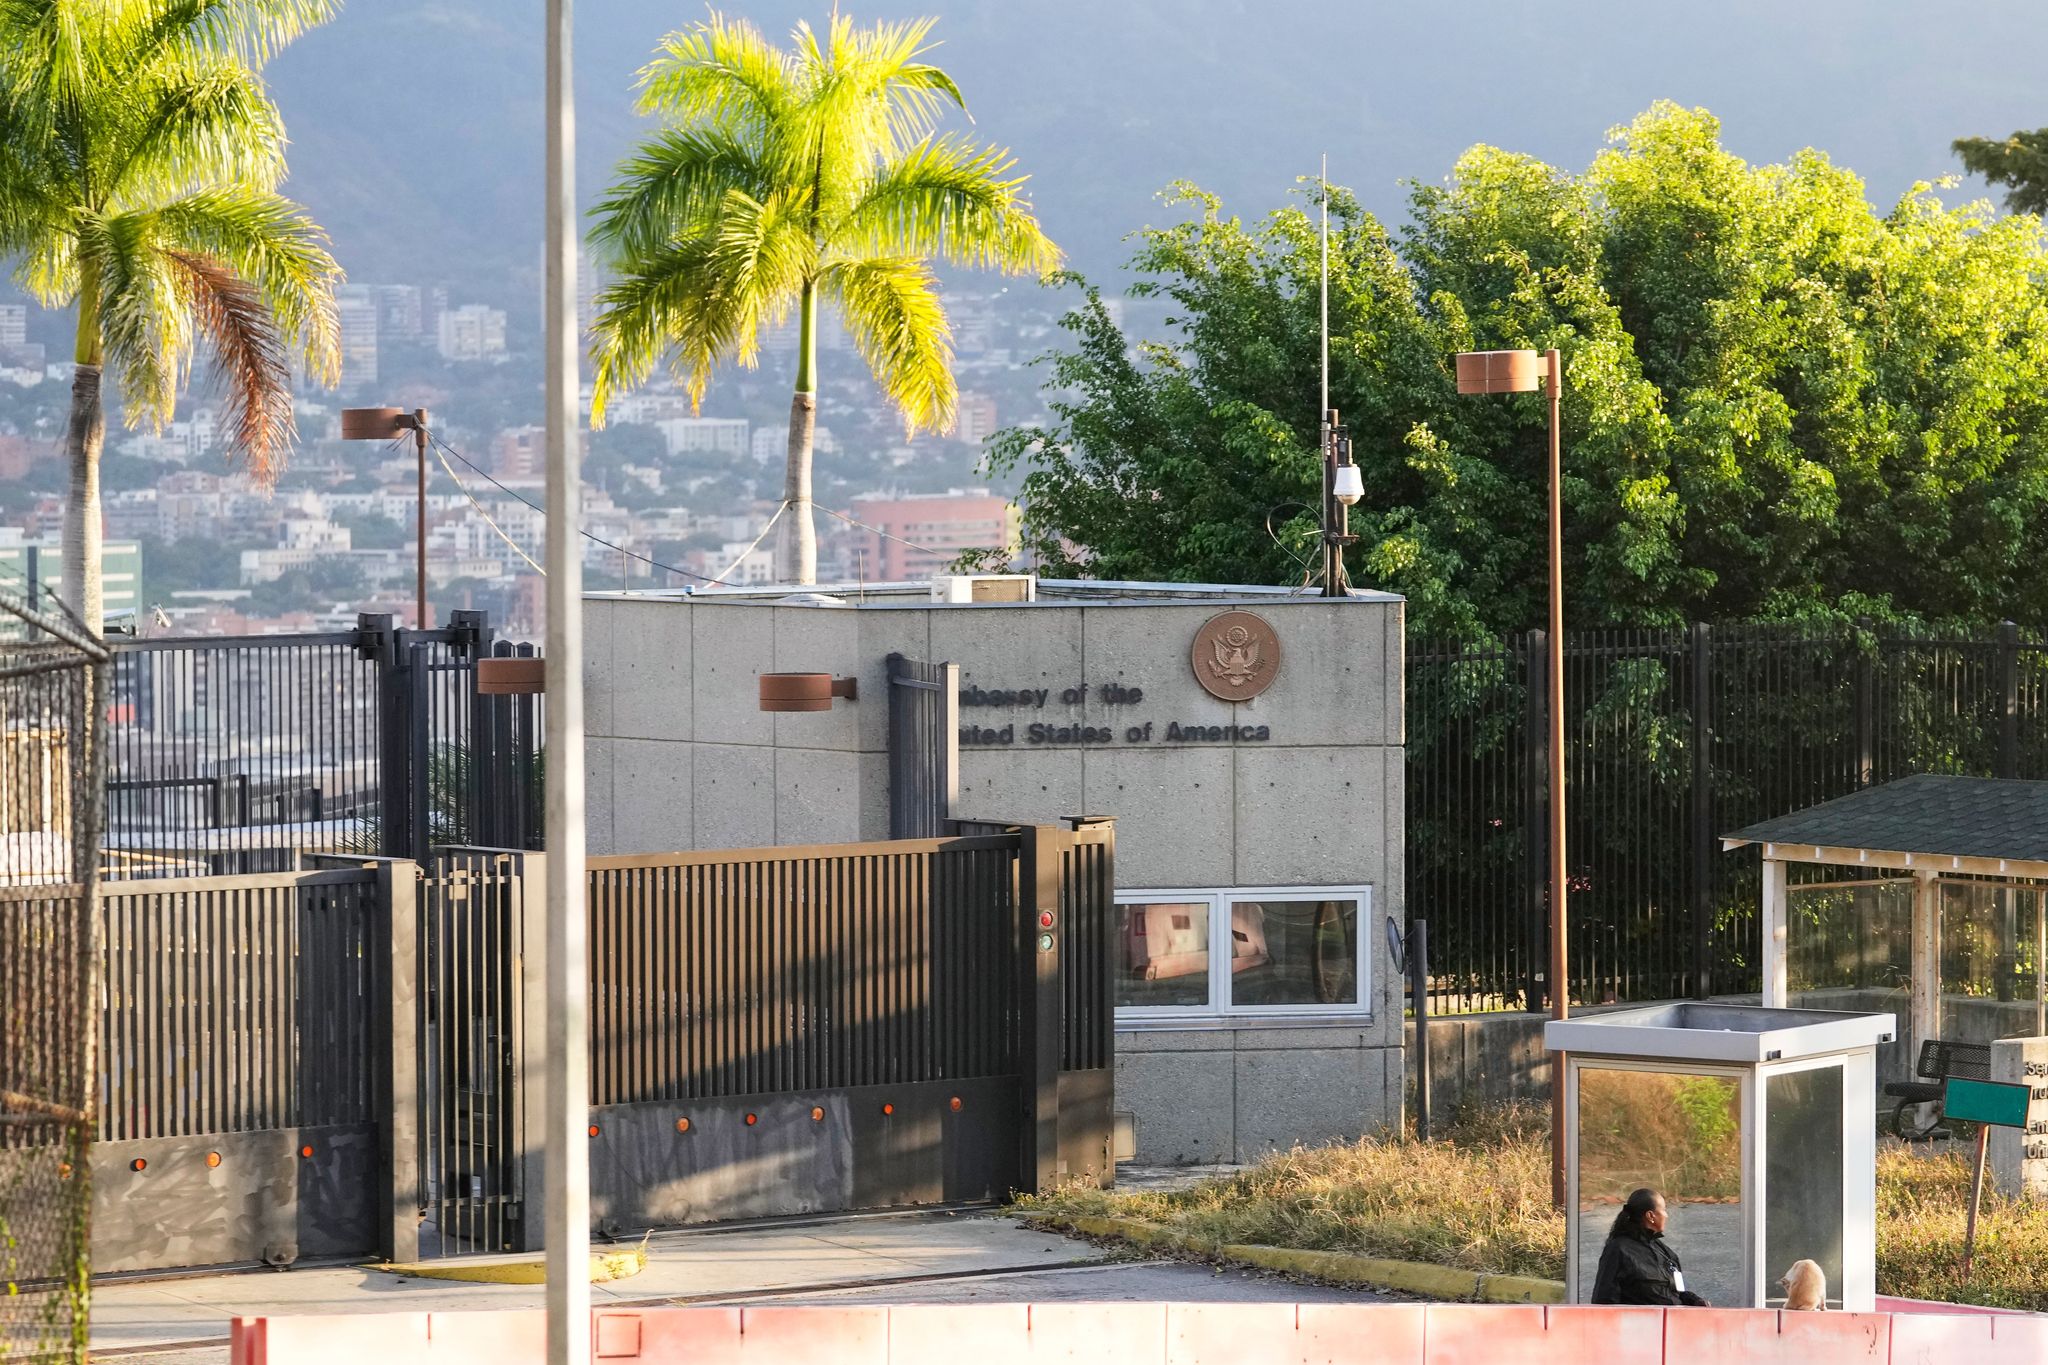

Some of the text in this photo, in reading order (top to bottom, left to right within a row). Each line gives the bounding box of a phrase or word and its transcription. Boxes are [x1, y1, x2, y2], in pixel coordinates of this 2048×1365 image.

[1062, 683, 1088, 705] of
[1101, 682, 1143, 705] the
[1028, 722, 1112, 744] States
[1126, 721, 1152, 743] of
[1166, 721, 1270, 742] America
